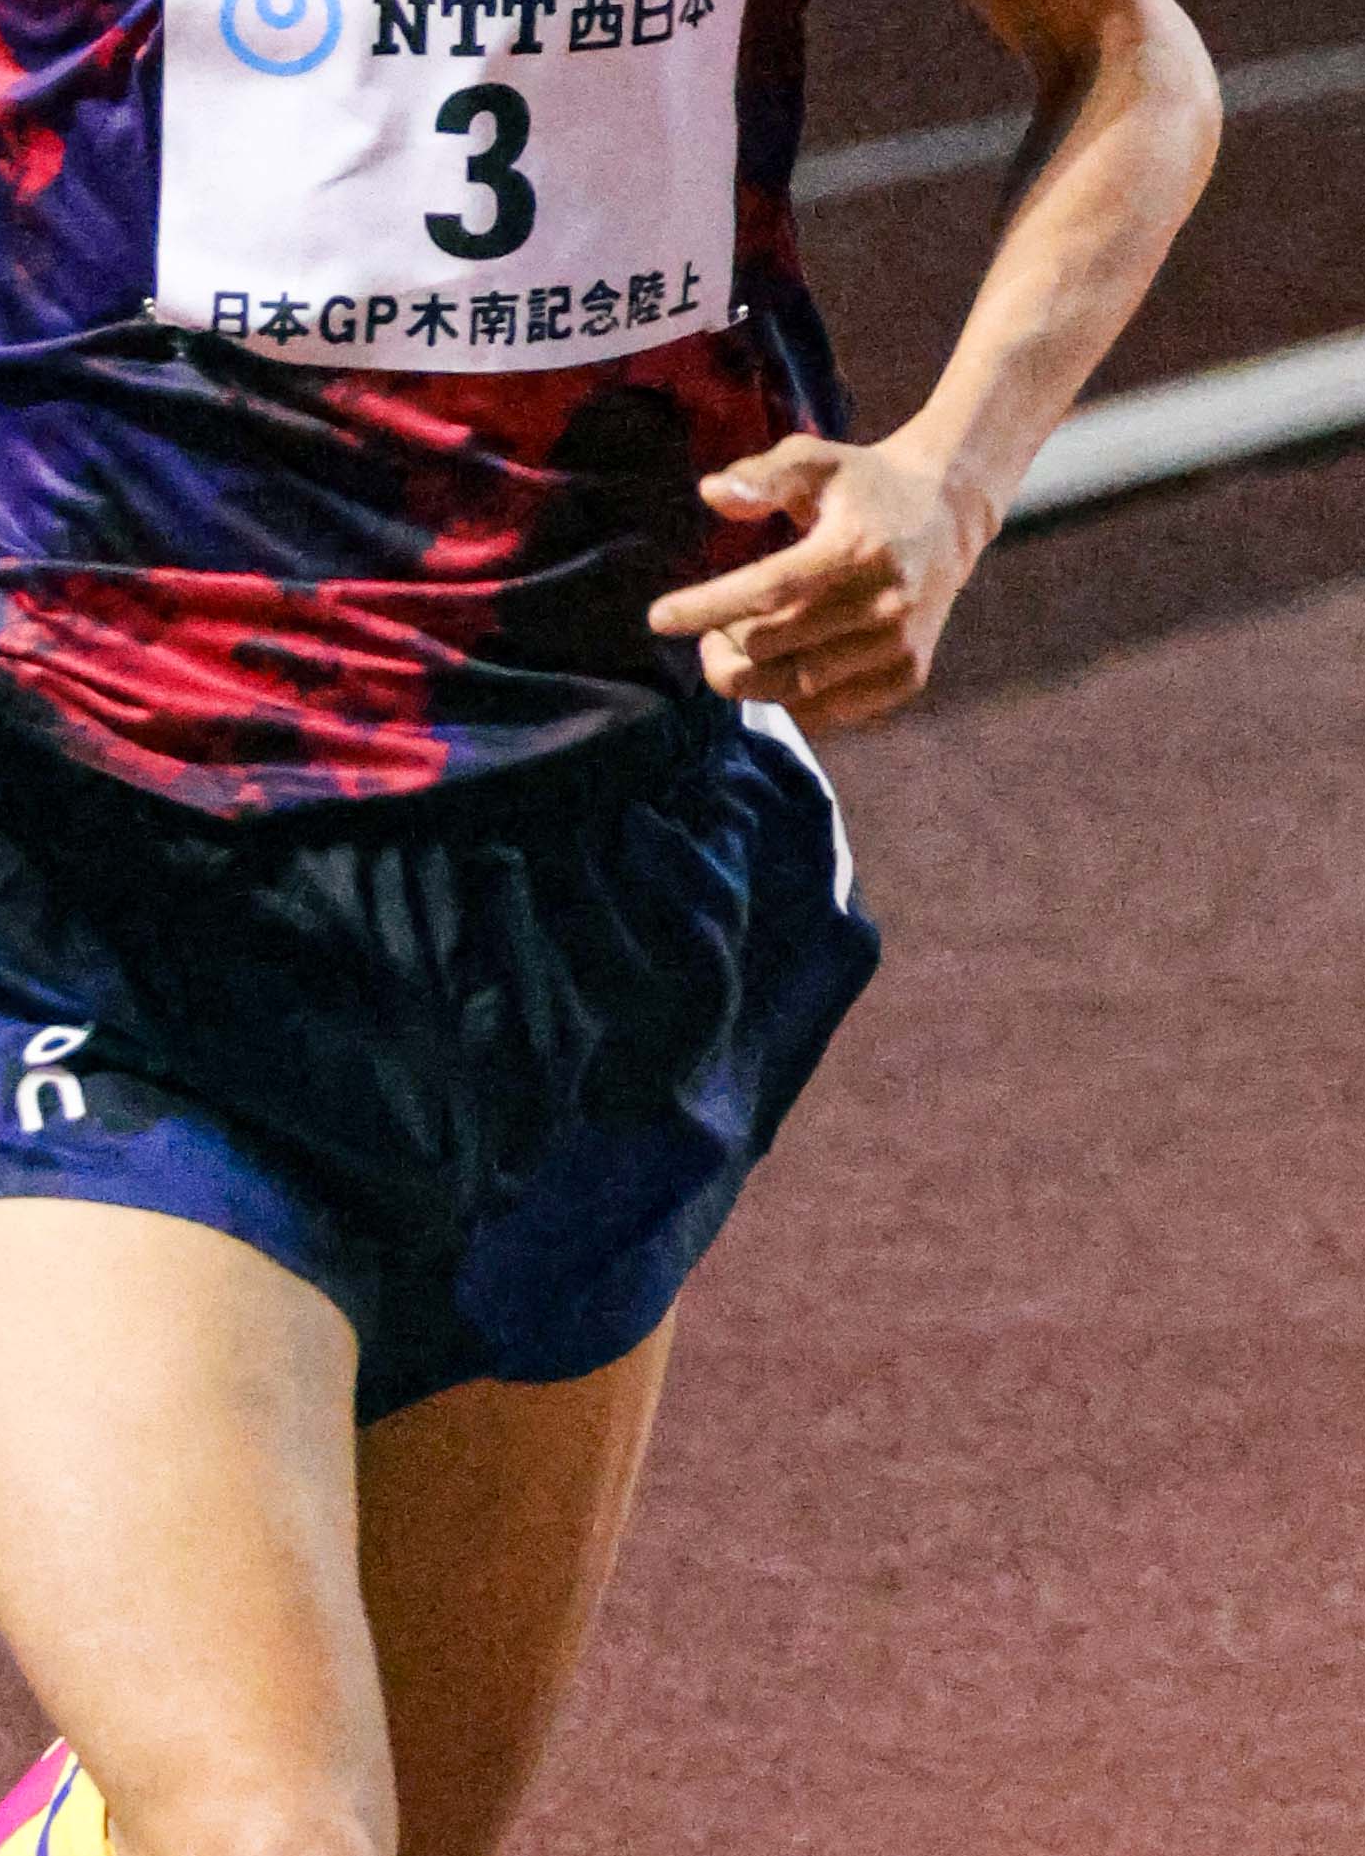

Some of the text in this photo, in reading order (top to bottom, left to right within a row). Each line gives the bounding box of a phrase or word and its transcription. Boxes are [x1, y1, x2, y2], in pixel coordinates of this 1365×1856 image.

[423, 83, 536, 261] 3
[211, 263, 701, 346] 日本GP木南記念陸上
